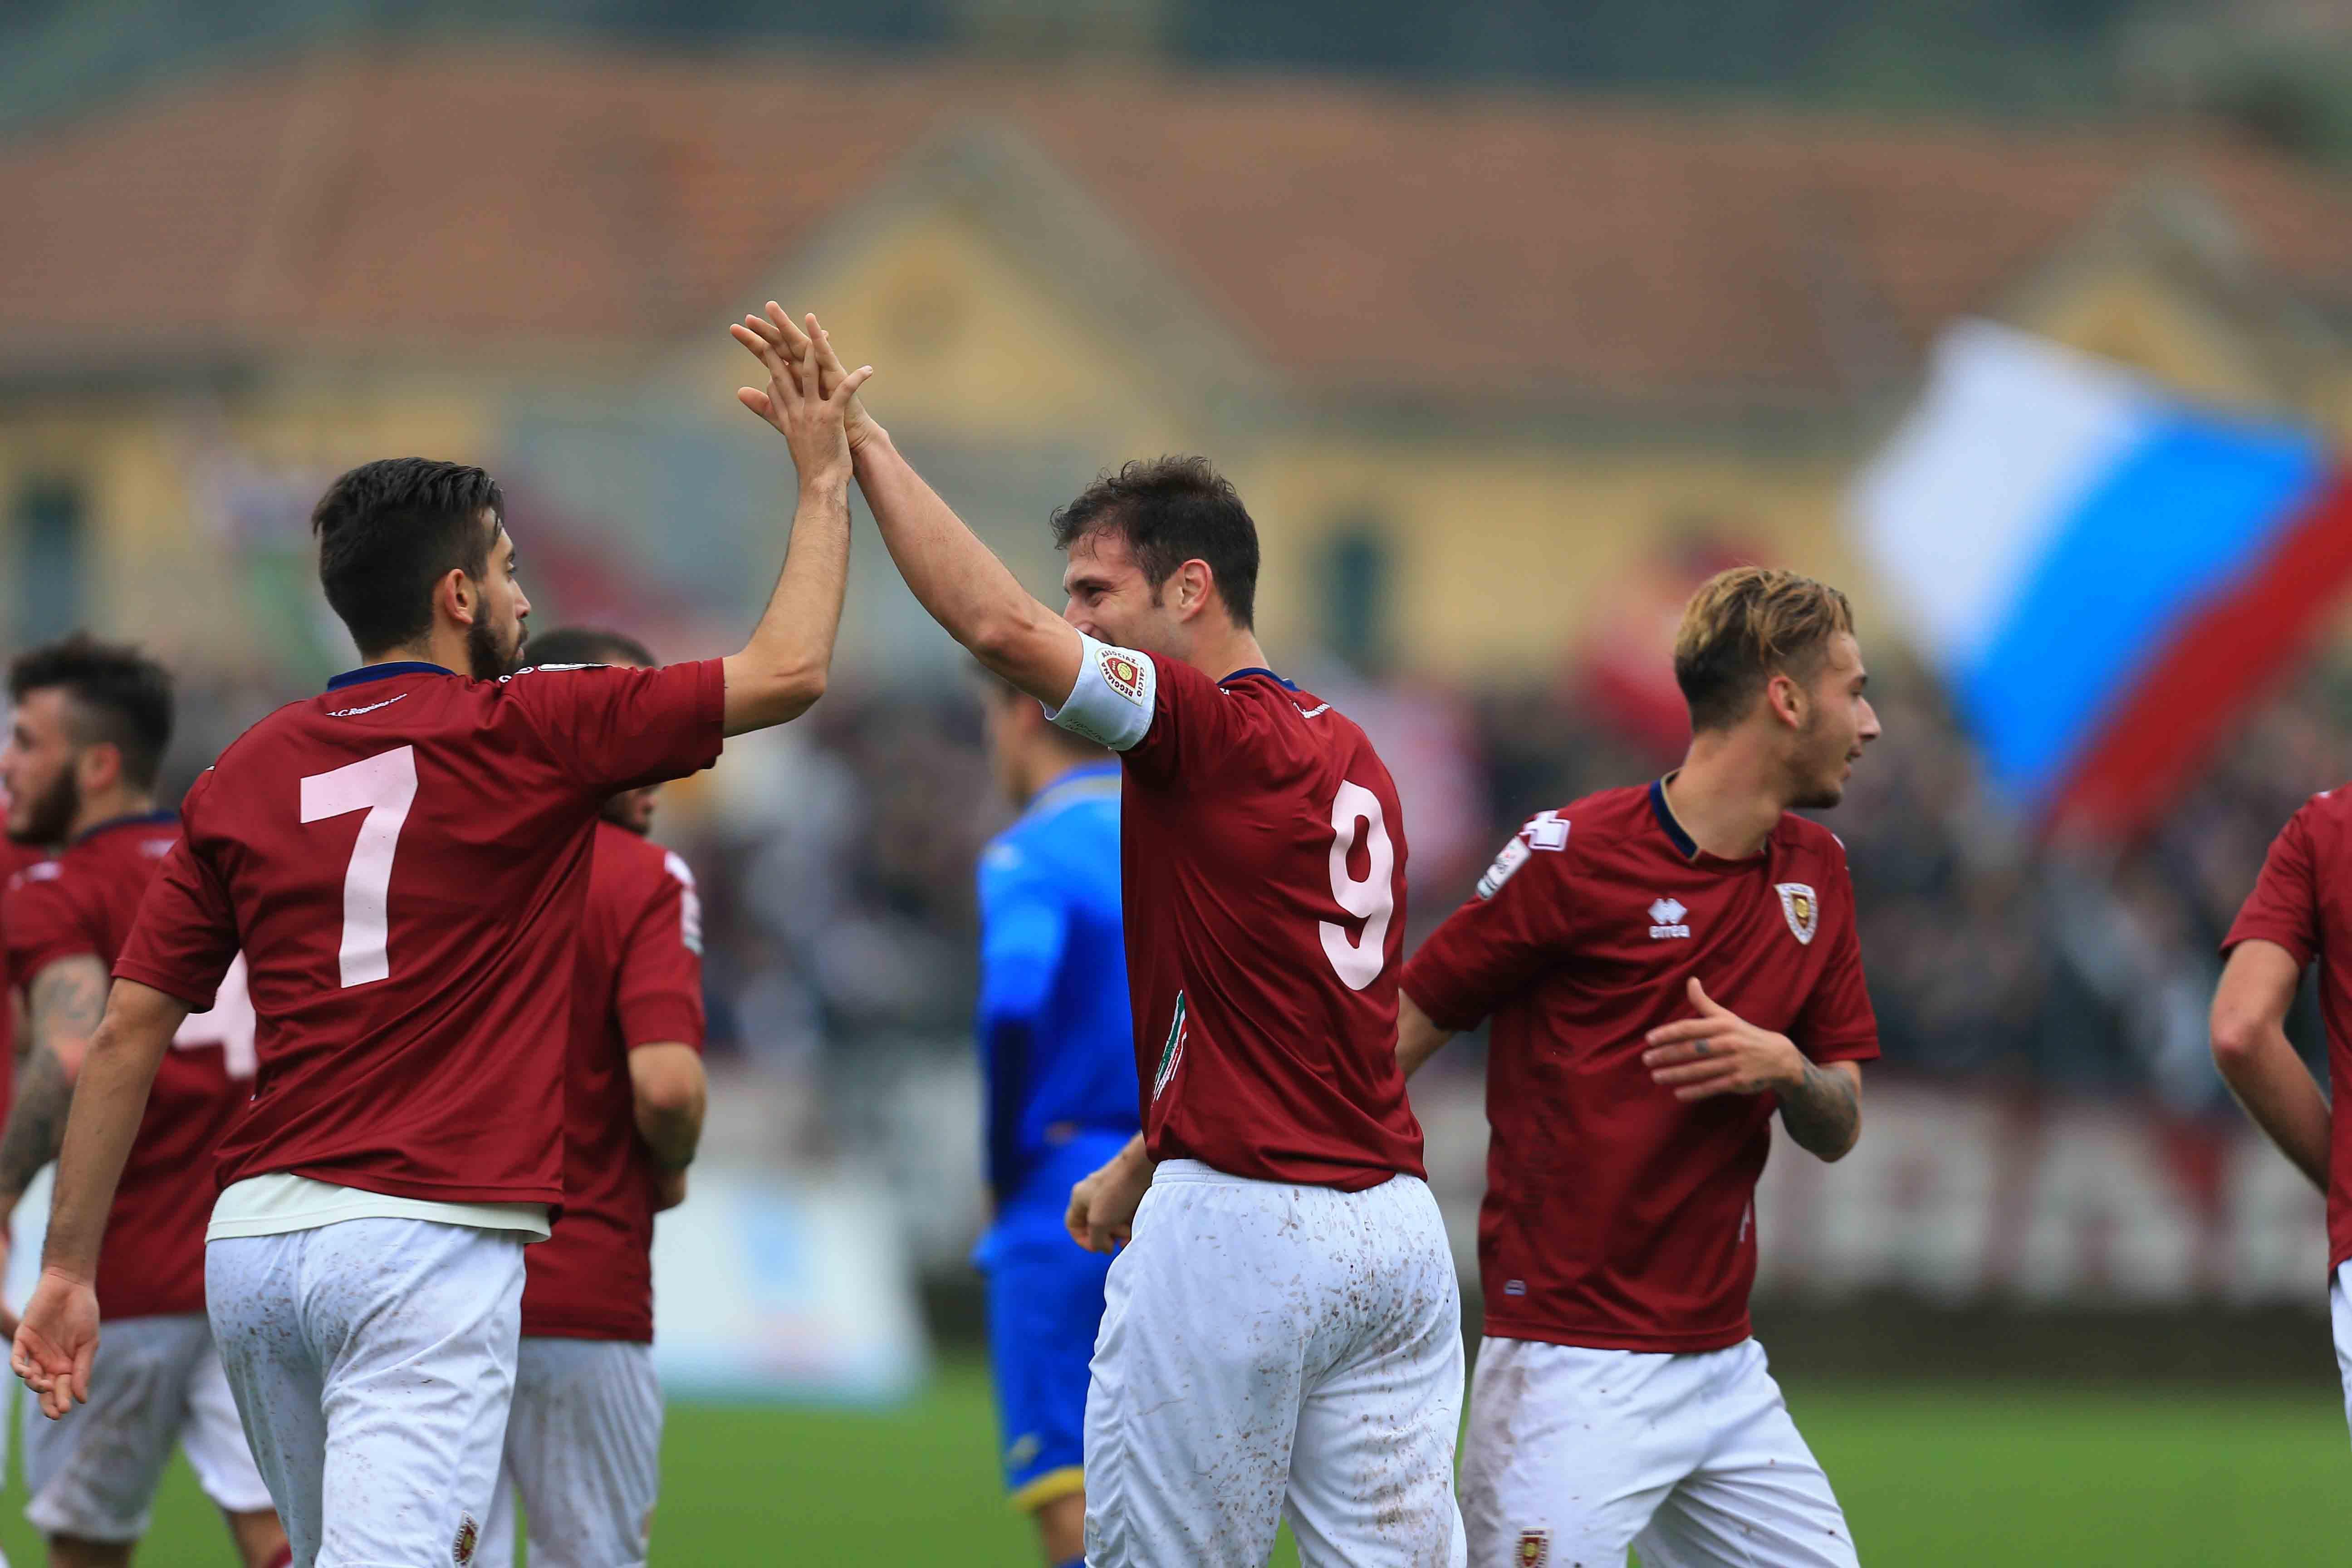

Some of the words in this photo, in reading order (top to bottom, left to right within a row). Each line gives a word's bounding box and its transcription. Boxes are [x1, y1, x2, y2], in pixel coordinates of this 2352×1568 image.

[1101, 650, 1139, 666] ASSOCIAZ.
[1137, 667, 1145, 697] CALCIO
[1101, 662, 1133, 697] REGGIANA
[300, 745, 418, 989] 7
[1319, 779, 1394, 990] 9
